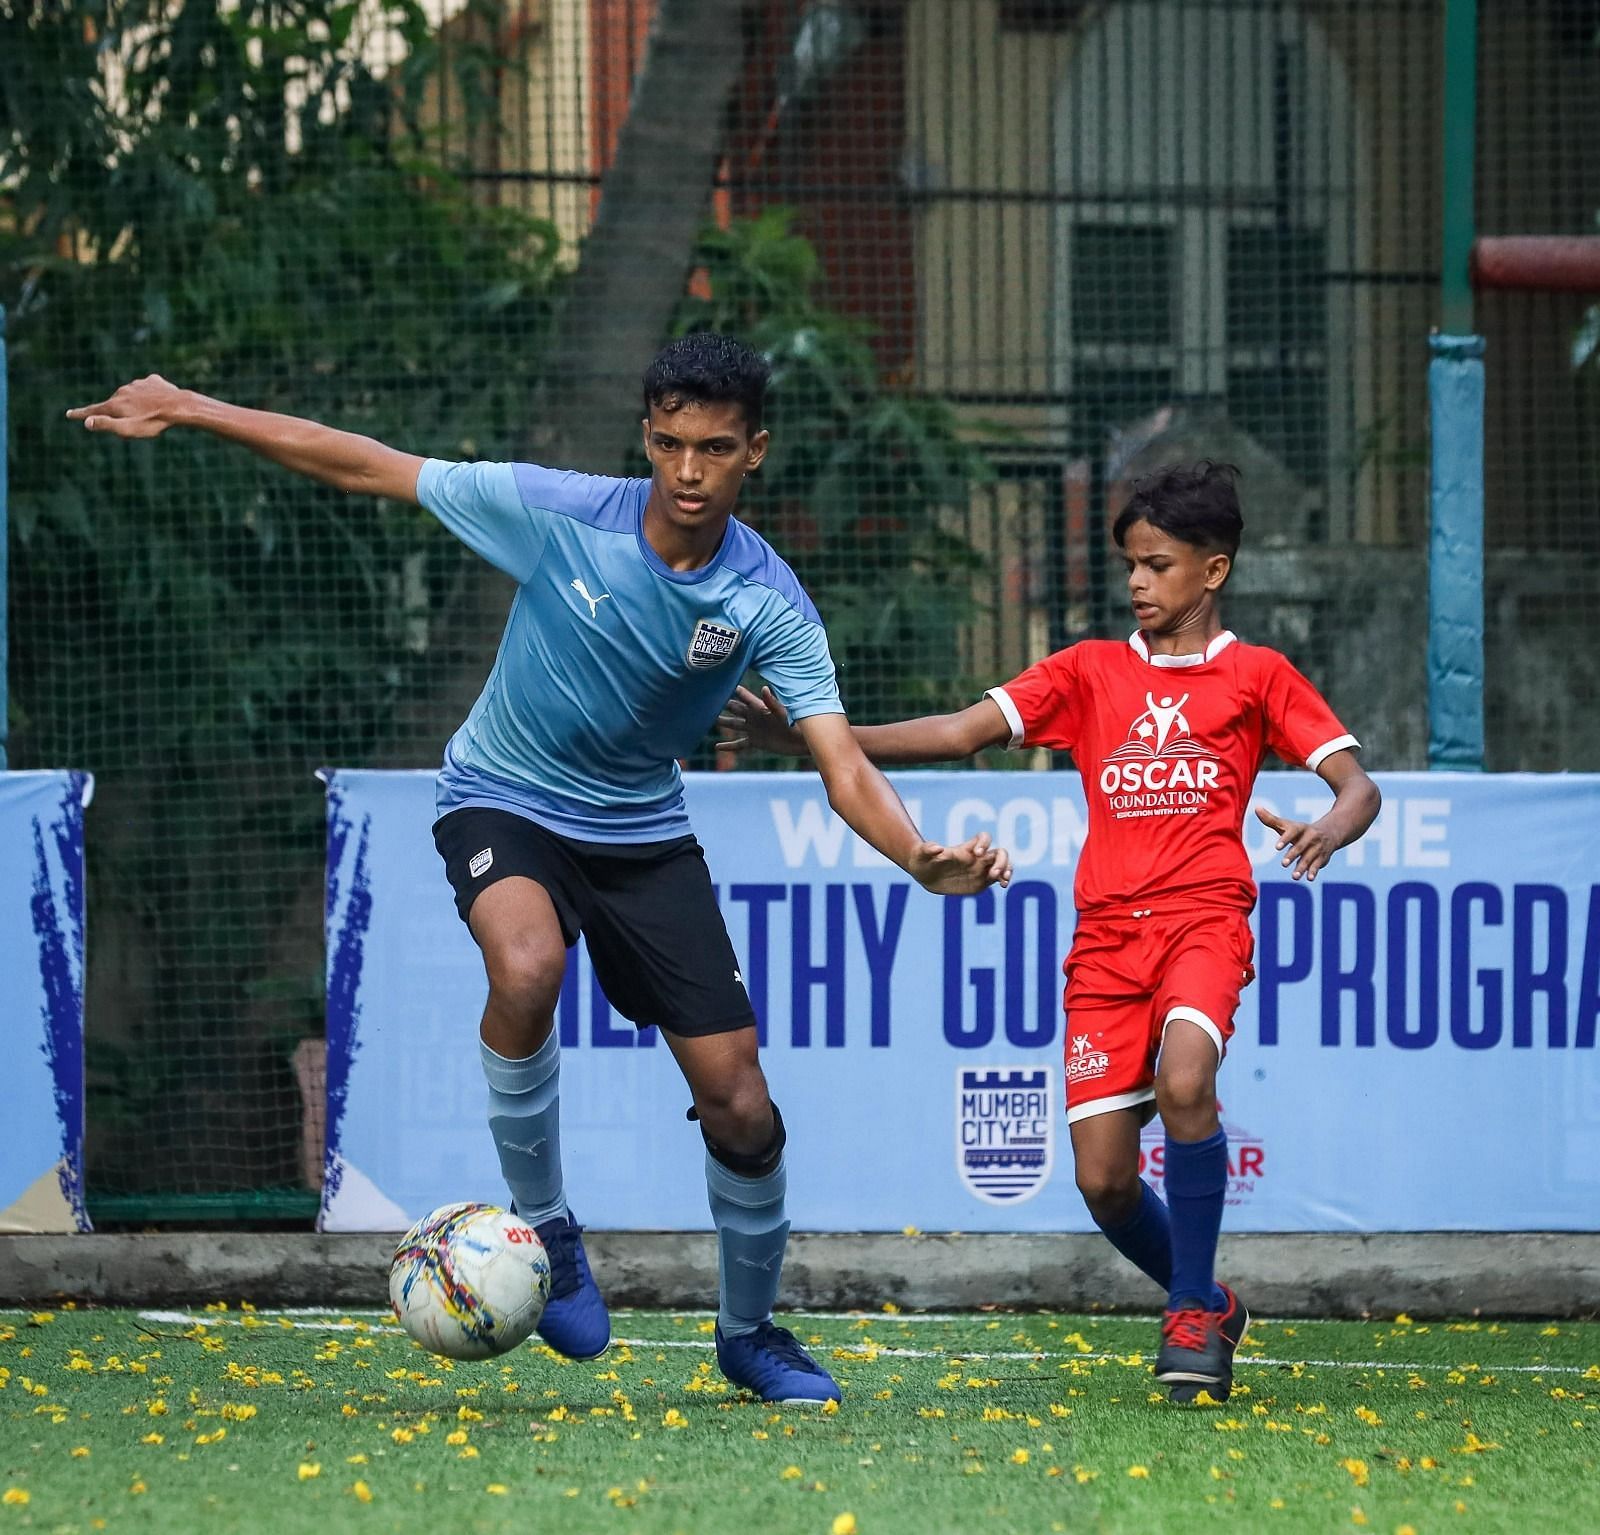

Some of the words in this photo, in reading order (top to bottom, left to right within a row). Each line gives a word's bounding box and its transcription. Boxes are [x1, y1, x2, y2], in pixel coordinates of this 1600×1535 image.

[694, 640, 716, 653] CITY
[697, 630, 734, 648] MUMBAI
[1100, 760, 1219, 794] OSCAR
[1109, 790, 1209, 810] FOUNDATION
[1174, 807, 1180, 815] A
[1180, 806, 1198, 815] KICK
[1065, 1055, 1110, 1077] OSCAR
[962, 1093, 1046, 1118] MUMBAI
[962, 1120, 1010, 1145] CITY
[1015, 1120, 1047, 1135] FC
